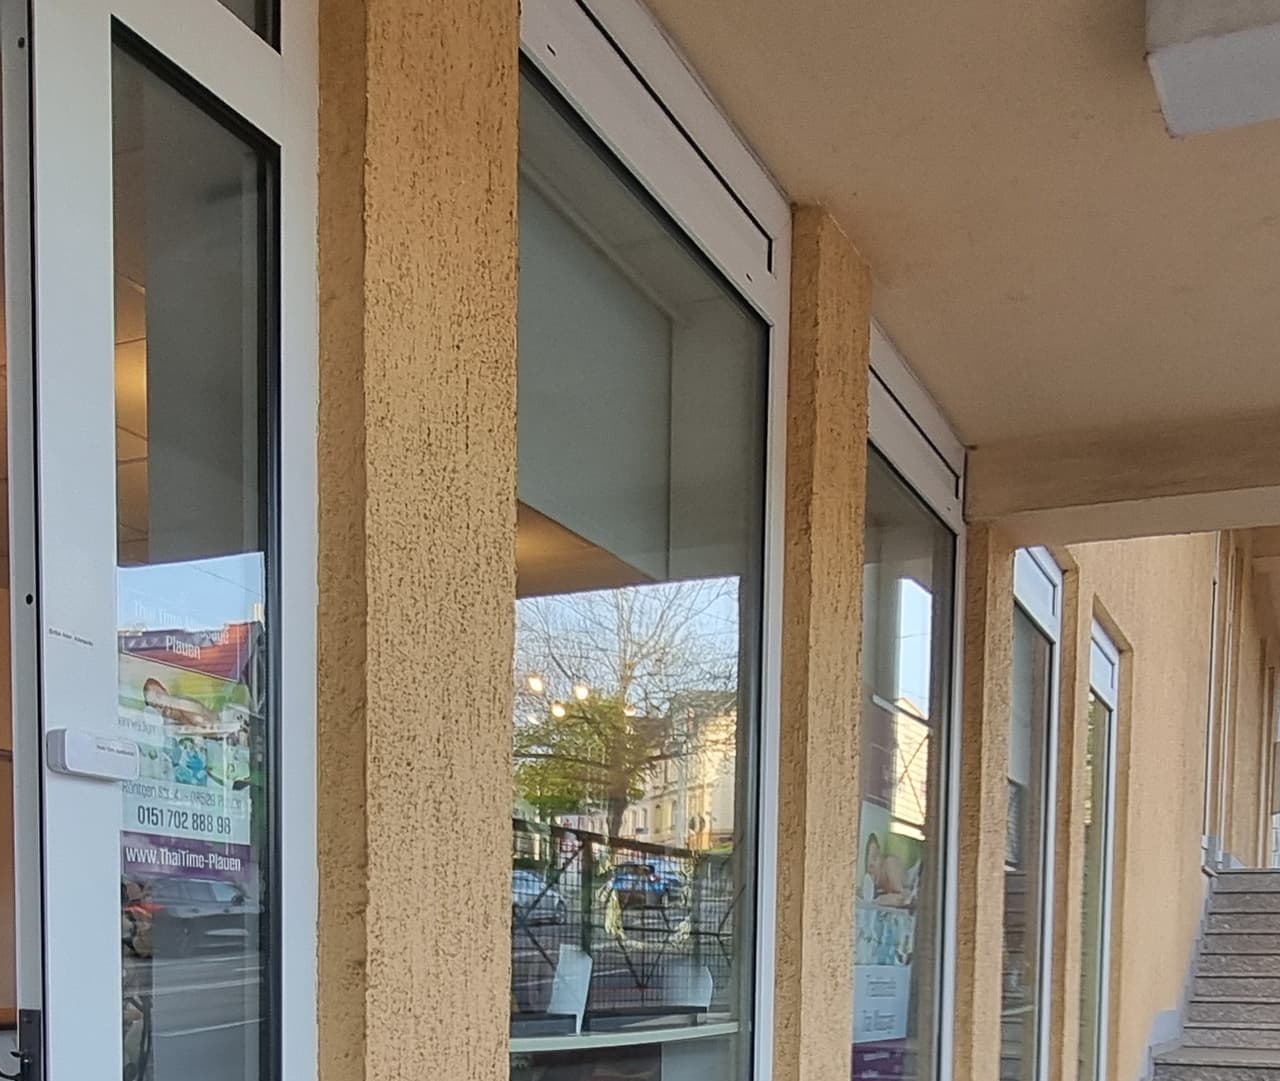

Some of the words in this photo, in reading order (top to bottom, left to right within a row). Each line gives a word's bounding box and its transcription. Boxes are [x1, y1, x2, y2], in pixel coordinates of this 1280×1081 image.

[165, 635, 200, 660] Plauen
[137, 805, 164, 827] 0151
[168, 808, 189, 830] 702
[192, 812, 214, 833] 888
[217, 816, 232, 835] 98
